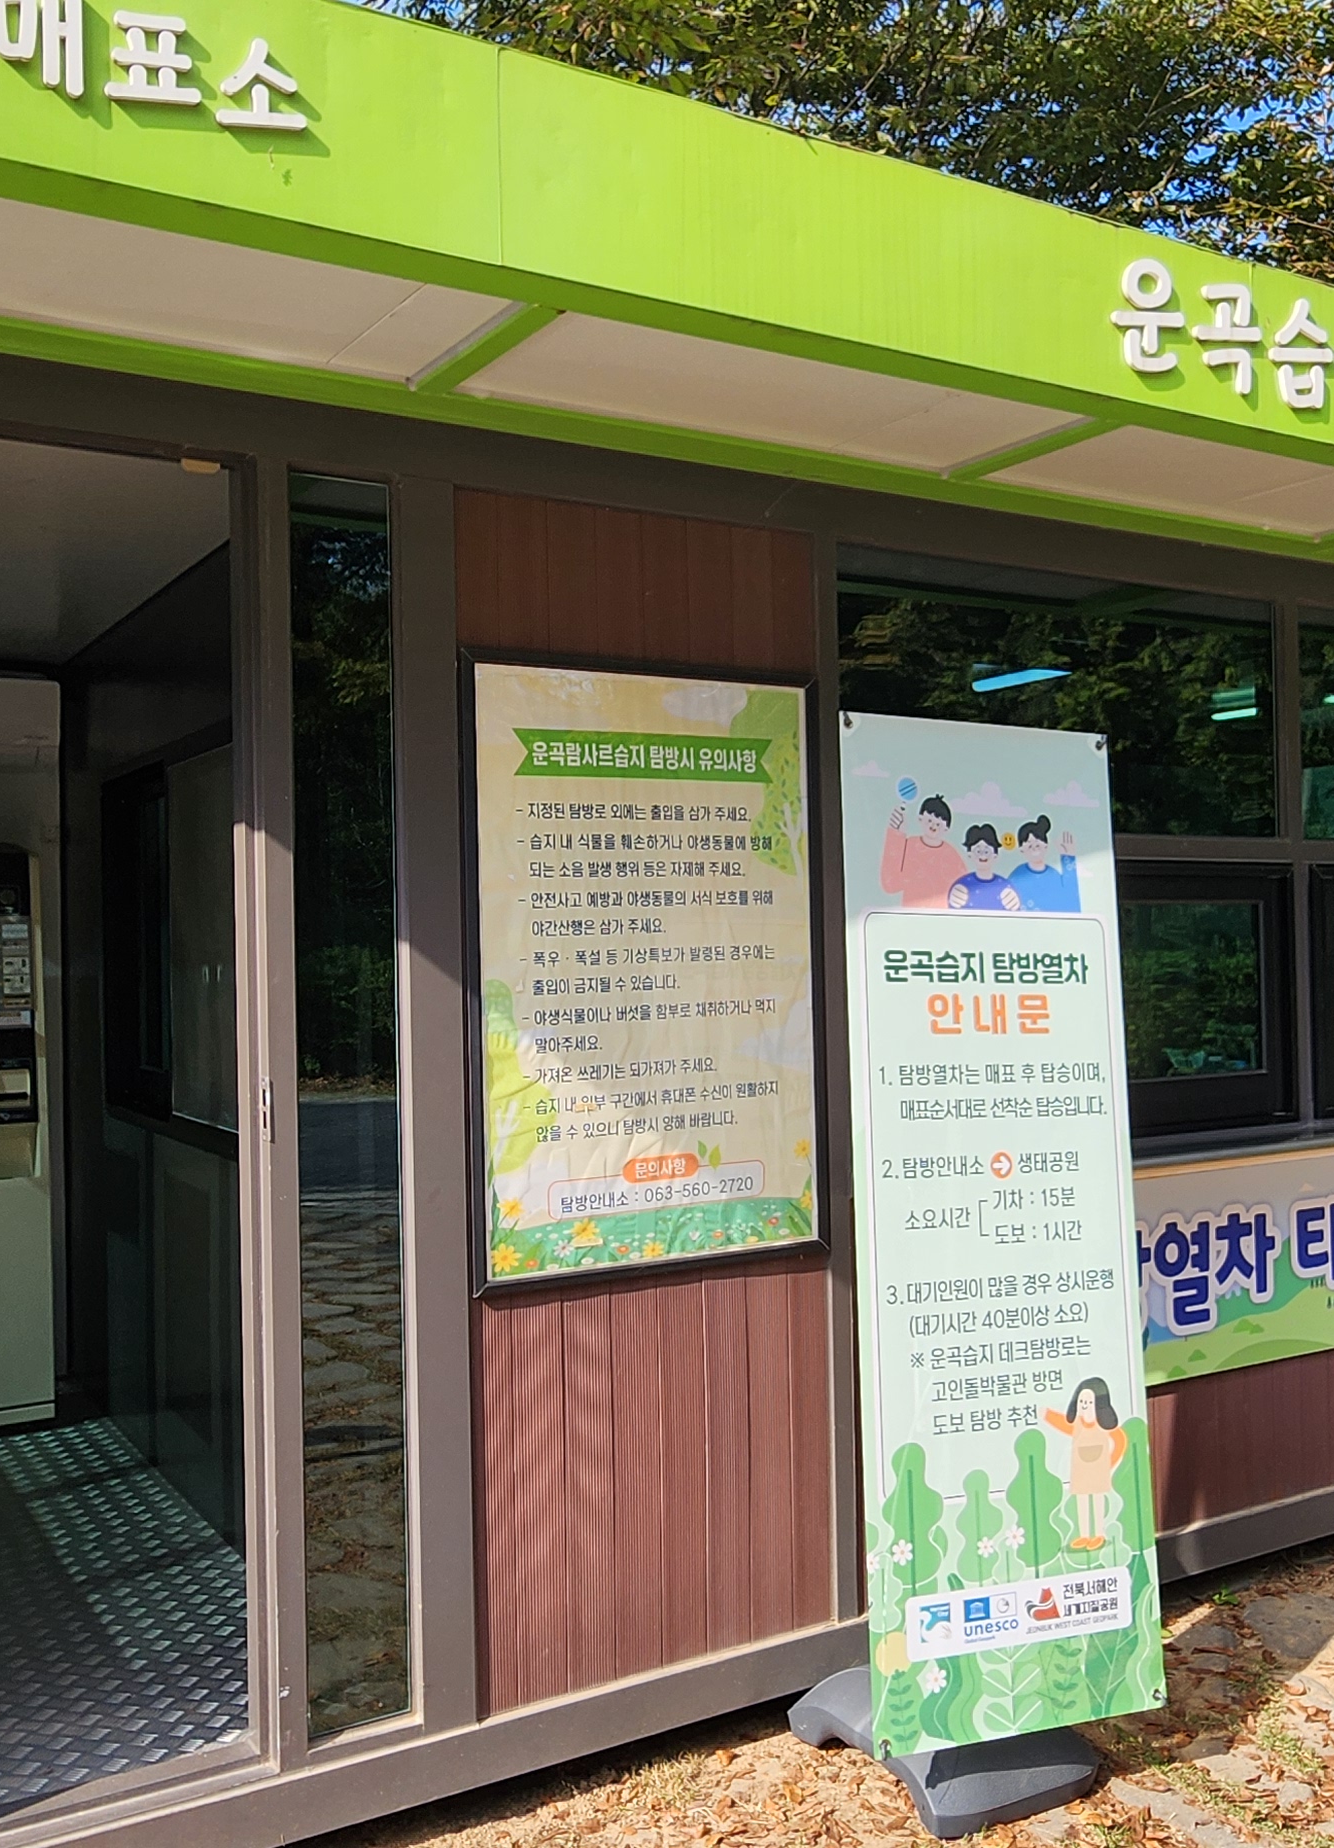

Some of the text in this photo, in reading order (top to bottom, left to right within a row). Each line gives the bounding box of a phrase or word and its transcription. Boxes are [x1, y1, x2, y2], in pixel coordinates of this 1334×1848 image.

[532, 741, 756, 773] 운곡람사르습지 탐방시 유의사항
[528, 803, 751, 822] 지정된 탐방로 외에는 출입을 삼가 주세요.
[530, 833, 772, 851] 습지 내 식물을 훼손하거나 야생동물에 방해
[531, 890, 773, 909] 안전사고 예방과 야생동물의 서식 보호를 위해
[532, 918, 666, 937] 야간산행은 삼가 주세요.
[883, 949, 1089, 985] 운곡습지 탐방열차
[879, 1062, 1106, 1087] 1. 탐방열차는 매표 후 탑승이며,
[900, 1095, 1108, 1121] 매표순서대로 선착순 탑승입니다.
[635, 1158, 686, 1179] 문의사항
[1017, 1151, 1080, 1174] 생태공원
[561, 1176, 753, 1213] 탐방안내소 063-560-2720
[993, 1187, 1076, 1211] 기차 15분
[905, 1207, 971, 1231] 소요시간
[995, 1220, 1082, 1245] 도보 1시간
[988, 1275, 1019, 1298] 많을
[1022, 1273, 1052, 1295] 경우
[1055, 1269, 1115, 1293] 상시운행
[909, 1302, 1089, 1338] (대기시간 40분이상 소요)
[930, 1335, 1091, 1370] 운곡습지 데크탐방로는
[932, 1370, 1063, 1402] 고인돌박물관 방면
[933, 1405, 1038, 1436] 도보 탐방 추천
[964, 1618, 1019, 1636] unesco
